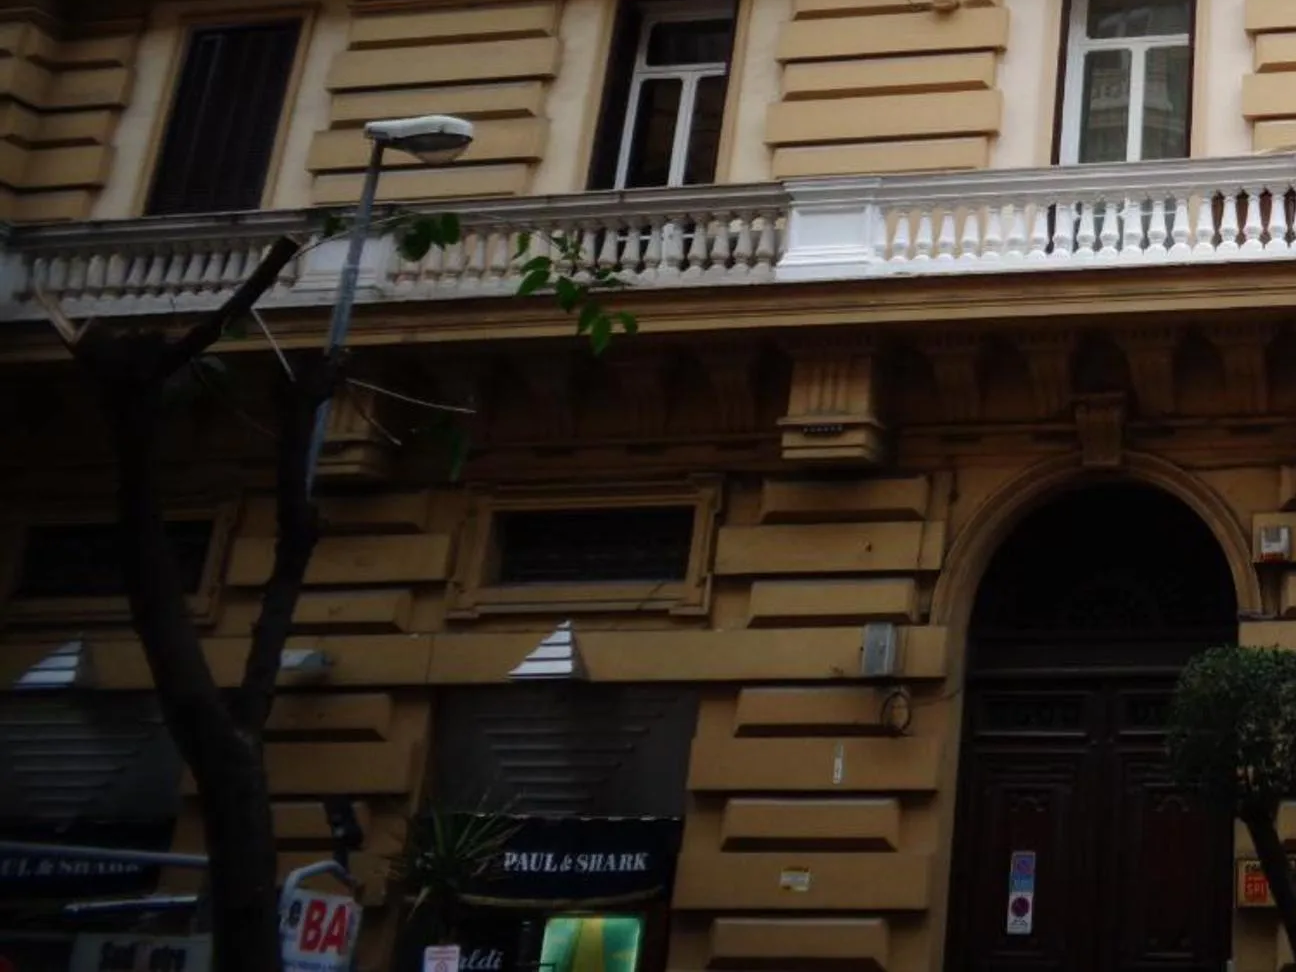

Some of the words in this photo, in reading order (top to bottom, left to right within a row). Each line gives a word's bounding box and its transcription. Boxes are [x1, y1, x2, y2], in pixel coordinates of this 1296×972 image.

[503, 851, 558, 873] PAUL
[559, 855, 573, 873] &
[576, 851, 650, 873] SHARK
